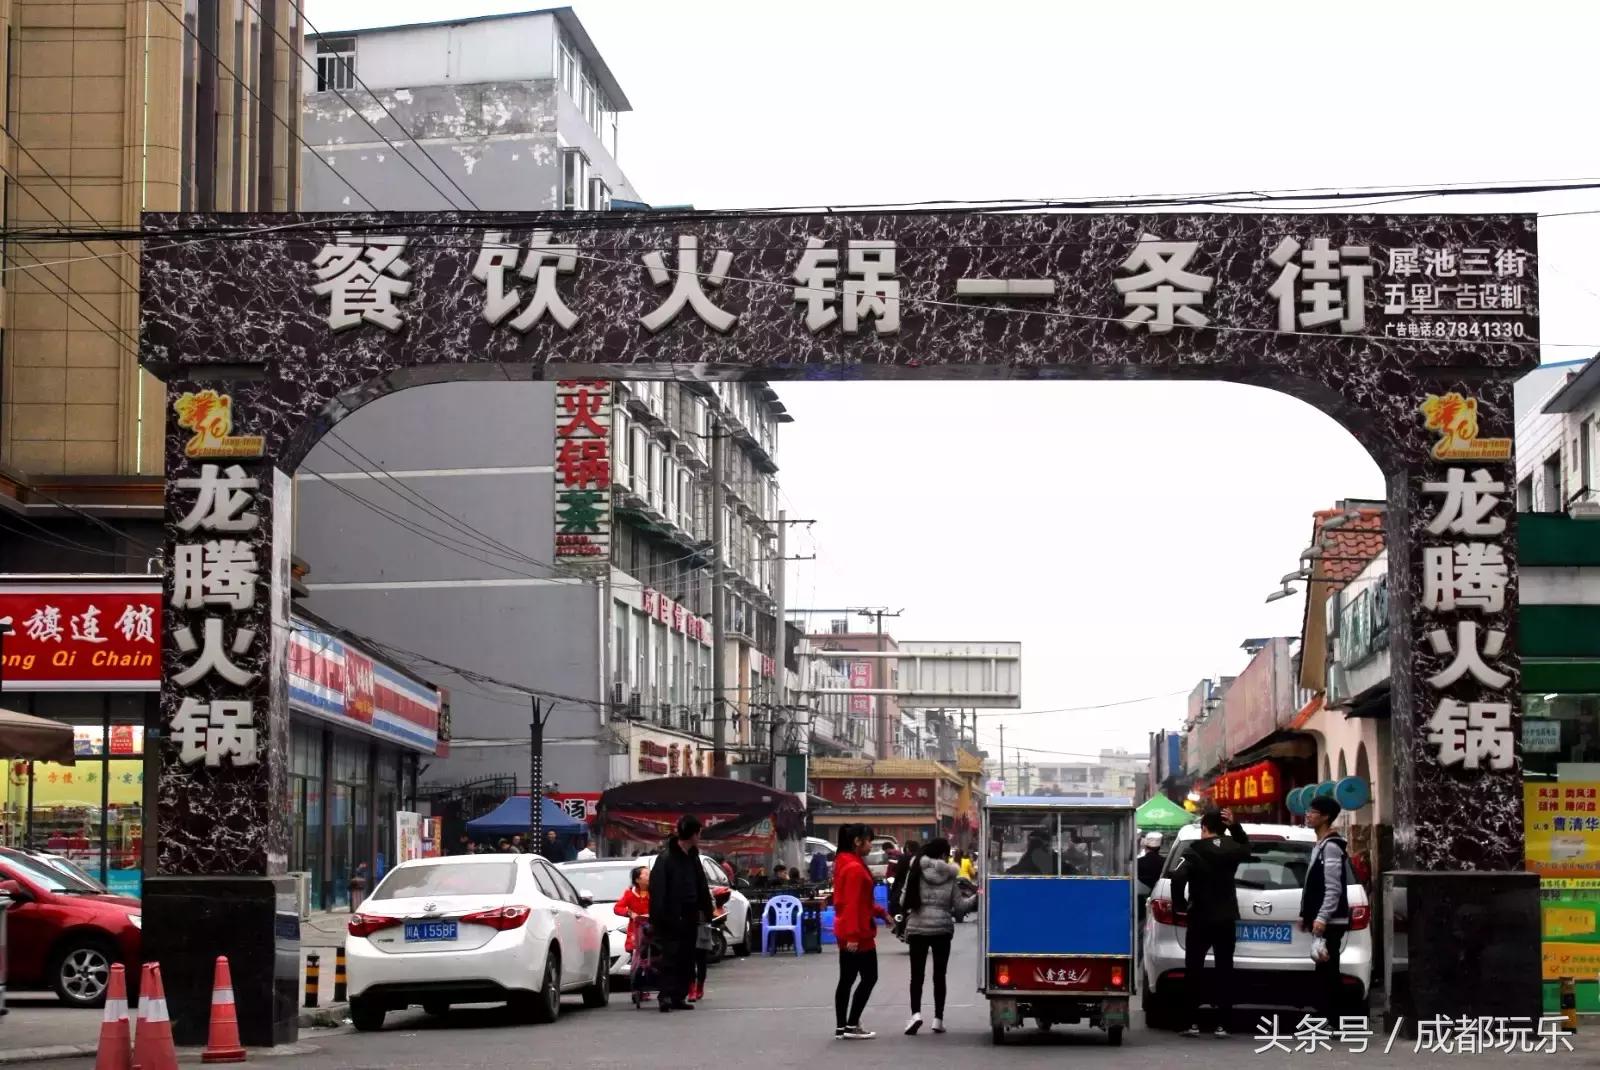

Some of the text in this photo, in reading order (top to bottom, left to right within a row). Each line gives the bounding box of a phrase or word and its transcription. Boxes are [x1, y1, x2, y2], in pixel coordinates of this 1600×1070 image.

[312, 230, 1373, 336] 餐饮火锅一条街
[1388, 248, 1527, 277] 犀池三街
[52, 650, 77, 666] Qi
[91, 651, 153, 667] Chain
[171, 464, 259, 767] 龙腾火锅
[1421, 467, 1514, 769] 龙腾火锅
